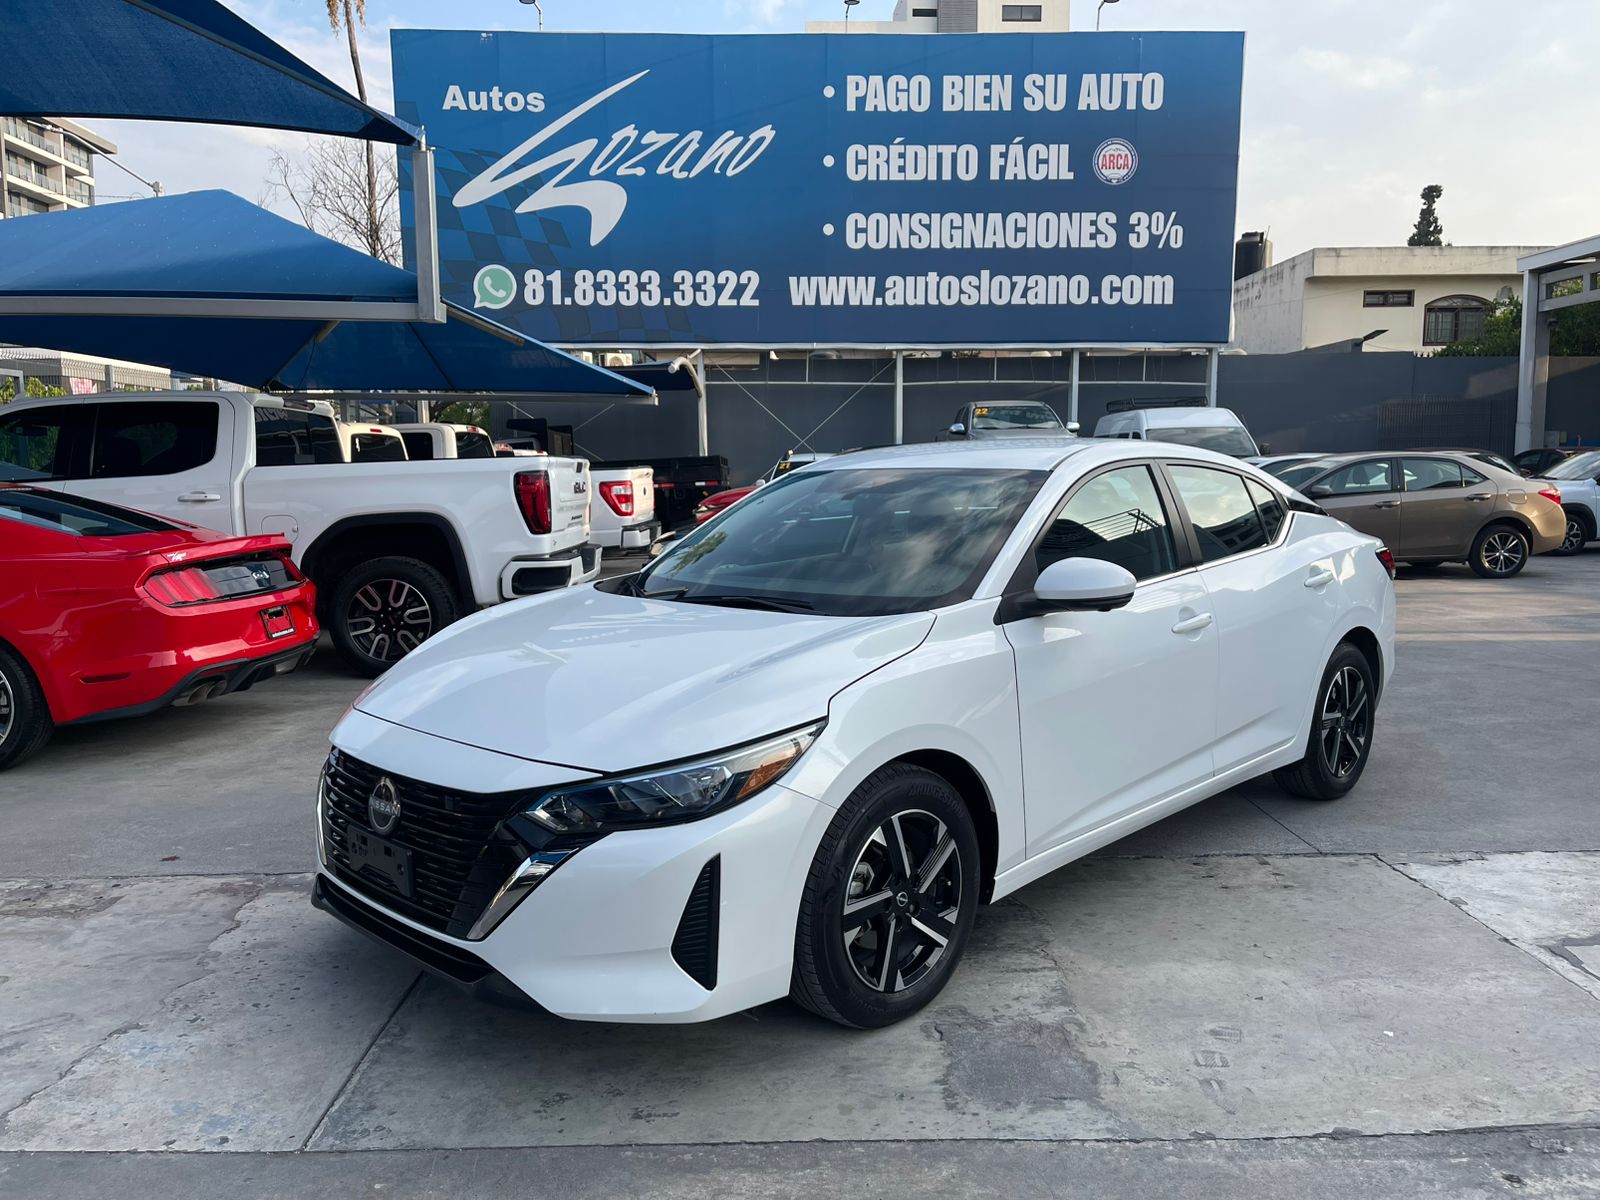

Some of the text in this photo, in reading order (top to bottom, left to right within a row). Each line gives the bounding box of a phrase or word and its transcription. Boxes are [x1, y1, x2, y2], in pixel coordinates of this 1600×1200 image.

[442, 85, 545, 113] Autos
[846, 73, 1164, 112] PAGO BIEN SU AUTO
[452, 69, 776, 247] Lozano
[846, 136, 1075, 181] CRÉDITO FÁCIL
[1101, 153, 1129, 170] ARCA
[846, 211, 1184, 249] CONSIGNACIONES 3%
[523, 268, 760, 306] 81.8333.3322
[788, 269, 1174, 306] www.autoslozano.com
